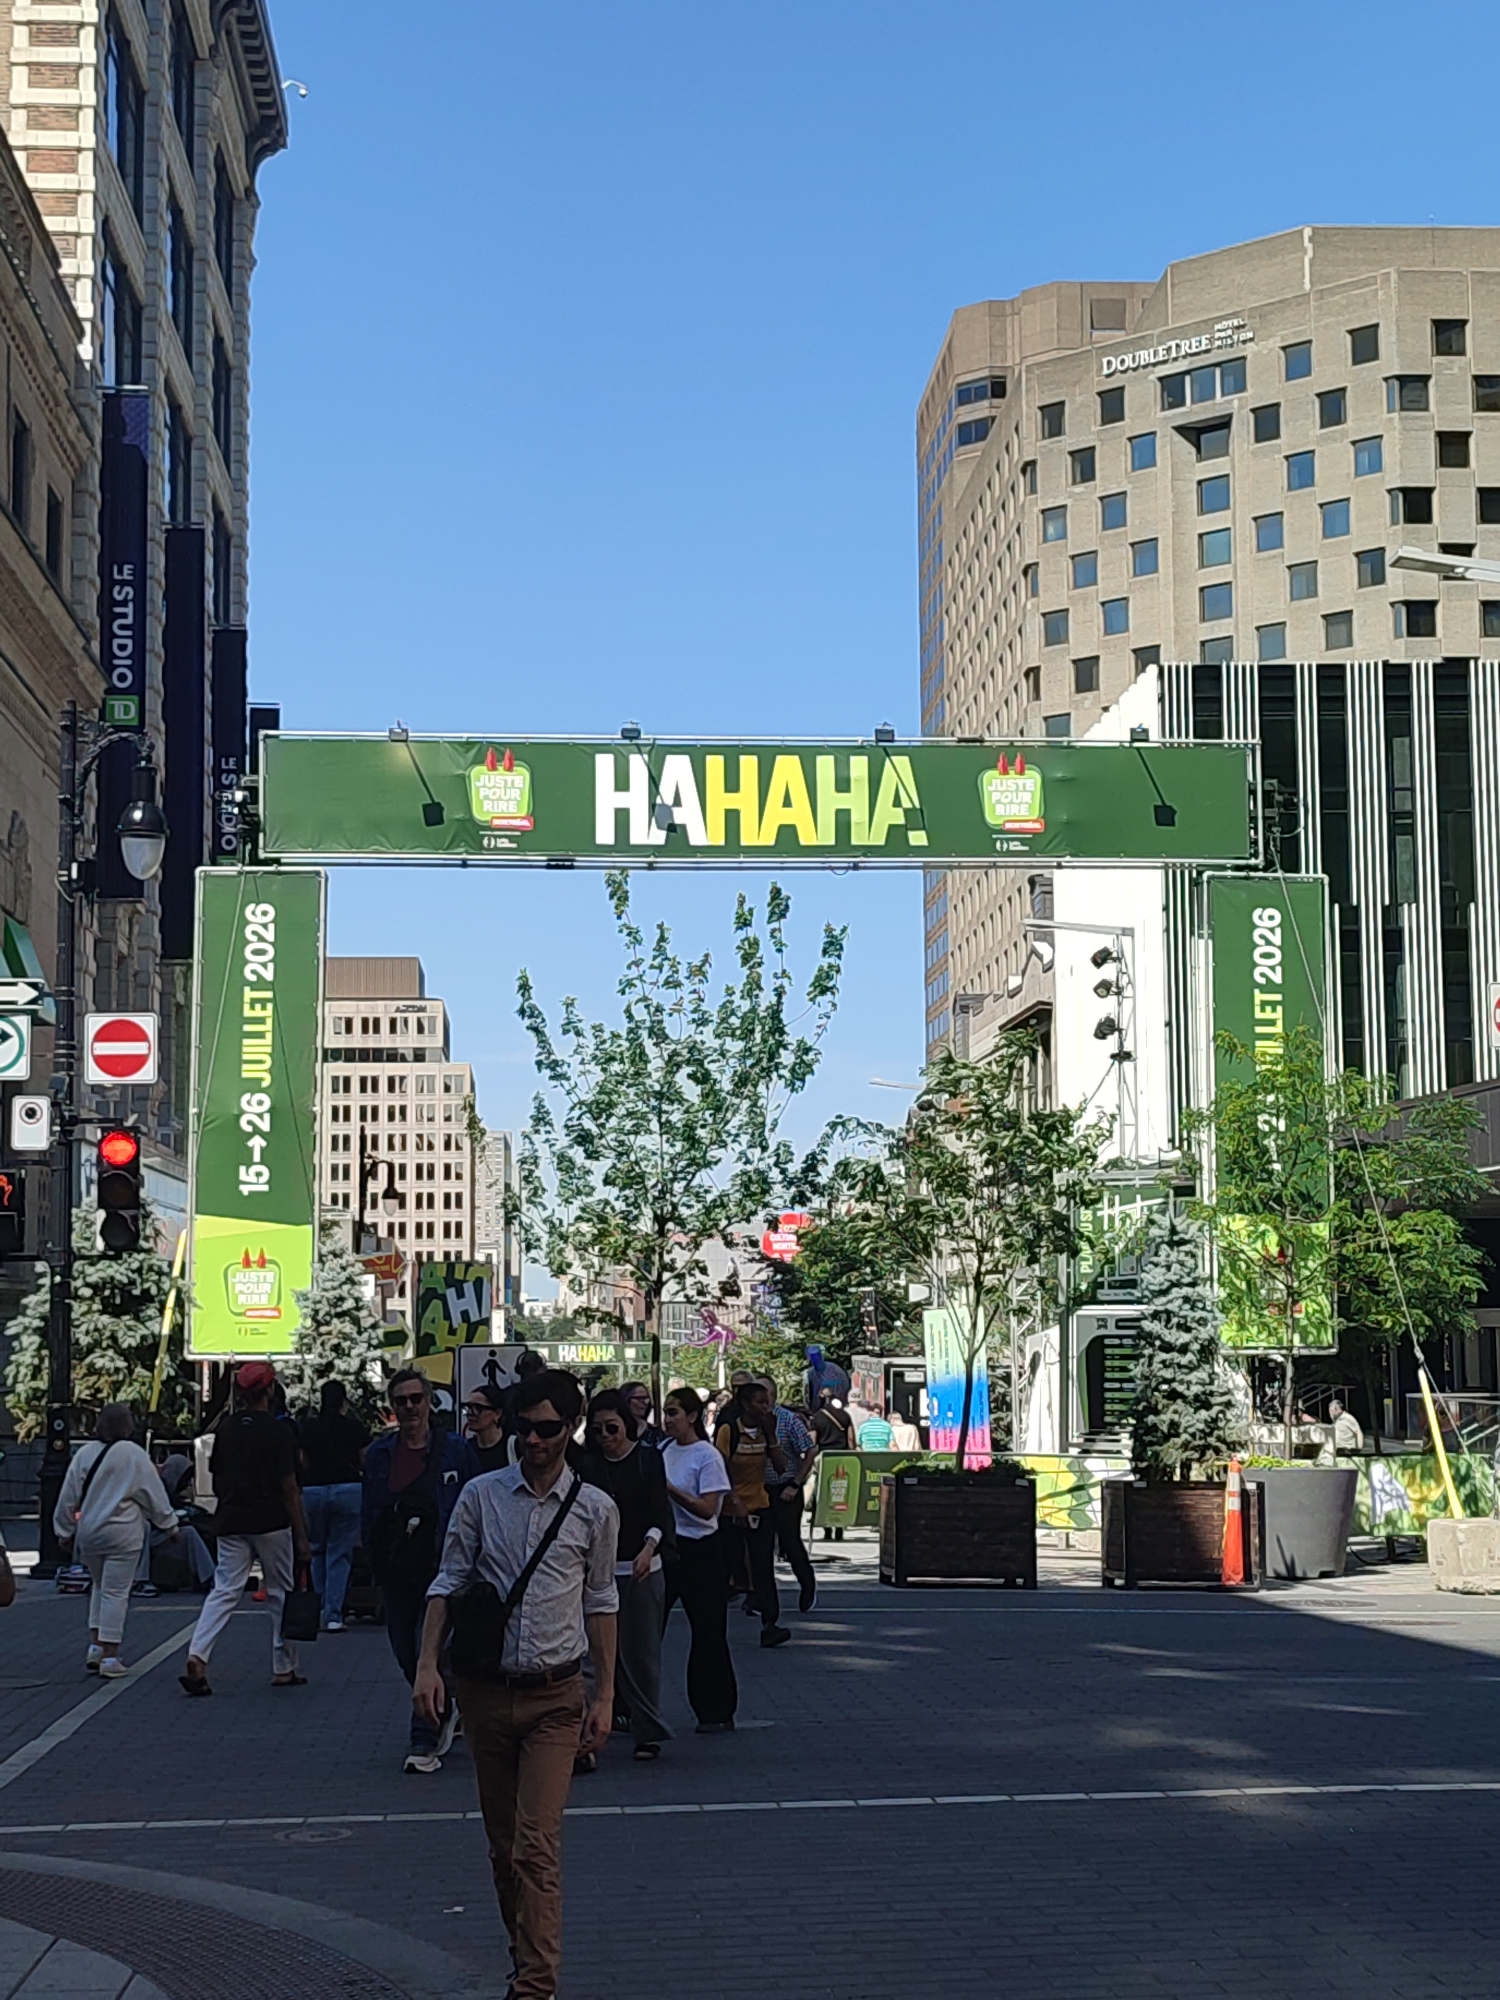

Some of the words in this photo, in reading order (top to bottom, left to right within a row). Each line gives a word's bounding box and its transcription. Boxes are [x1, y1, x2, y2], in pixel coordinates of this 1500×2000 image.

[112, 563, 135, 581] LE
[111, 584, 135, 689] STUDIO
[109, 700, 136, 720] TD
[221, 757, 237, 770] LE
[475, 775, 523, 787] JUSTE
[987, 778, 1036, 791] JUSTE
[479, 788, 521, 800] POUR
[594, 753, 929, 847] HAHAHA
[991, 791, 1033, 804] POUR
[483, 800, 518, 813] RIRE
[995, 803, 1030, 816] RIRE
[243, 902, 276, 982] 2026
[1252, 907, 1283, 985] 2026
[241, 986, 274, 1088] JUILLET
[239, 1092, 271, 1133] 26
[238, 1164, 270, 1196] 15
[231, 1271, 275, 1283] JUSTE
[234, 1282, 272, 1294] POUR
[559, 1344, 616, 1363] HAHAHA
